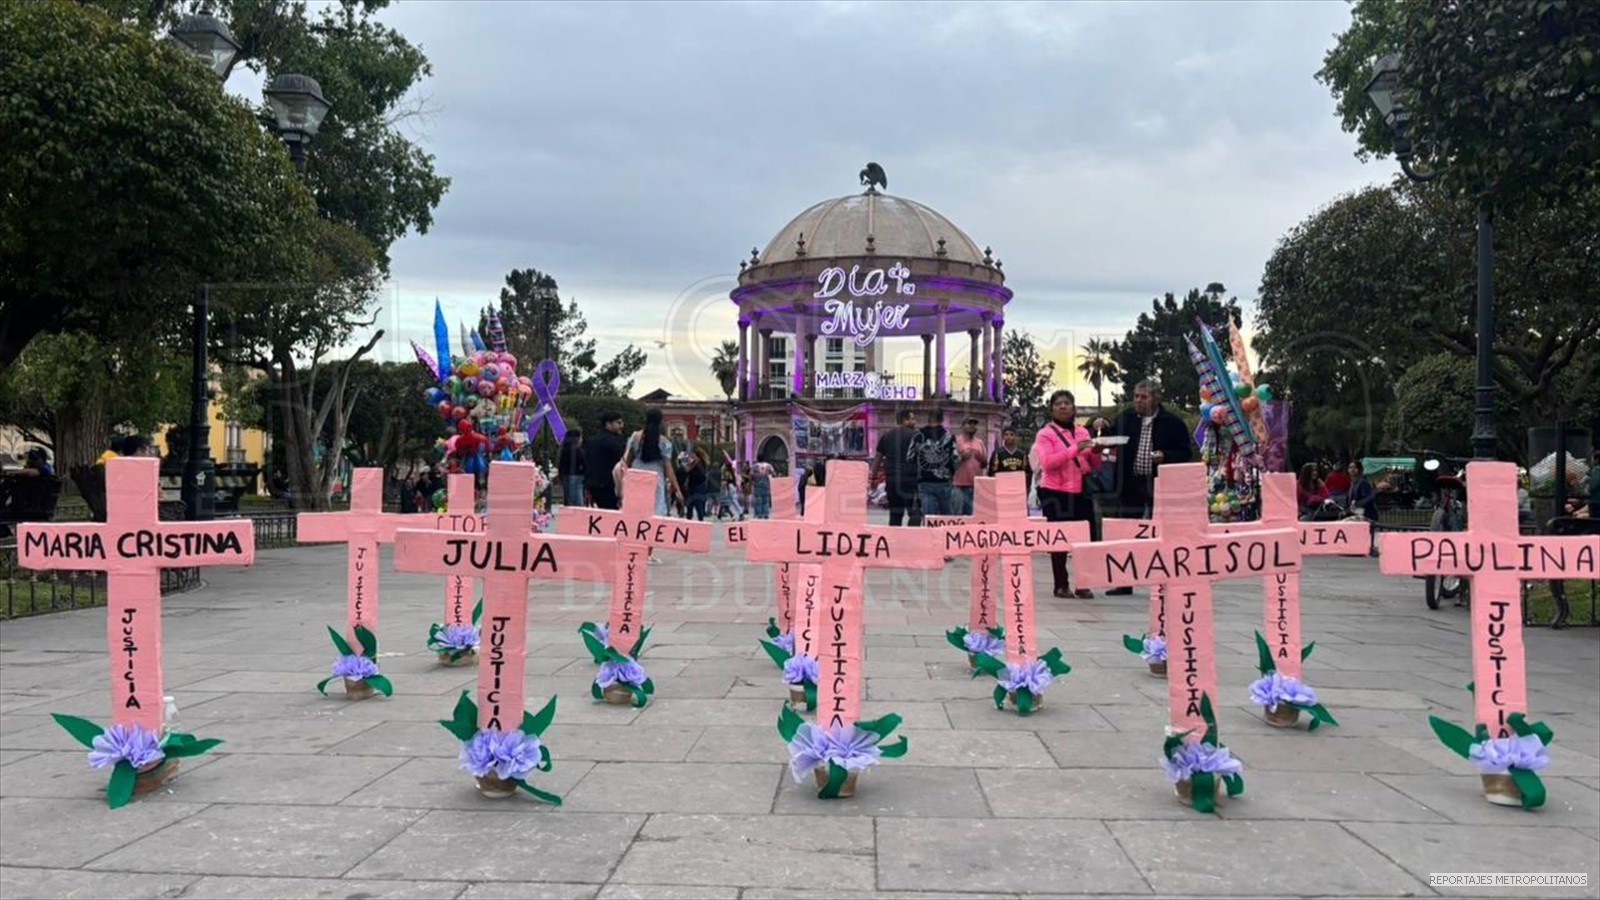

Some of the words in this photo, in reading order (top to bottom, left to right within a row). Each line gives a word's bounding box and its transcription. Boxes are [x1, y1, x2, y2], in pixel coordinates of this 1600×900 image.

[821, 299, 910, 347] Mujer
[25, 531, 106, 559] MARIA
[116, 530, 243, 558] CRISTINA
[587, 515, 690, 544] KAREN
[728, 527, 748, 542] EL
[796, 530, 890, 558] LIDIA
[945, 529, 1068, 550] MAGDALENA
[443, 540, 557, 572] JULIA
[1105, 541, 1296, 583] MARISOL
[1411, 538, 1594, 572] PAULINA
[355, 547, 367, 627] JUSTICI
[618, 552, 639, 634] JUSTICIA
[781, 562, 791, 634] JUSTICI
[1010, 563, 1026, 655] JUSTICIA
[802, 575, 818, 657] JUSTICI
[122, 608, 141, 709] JUSTICIA
[486, 616, 511, 732] JUSTICIA
[1182, 592, 1201, 717] JUSTICIA
